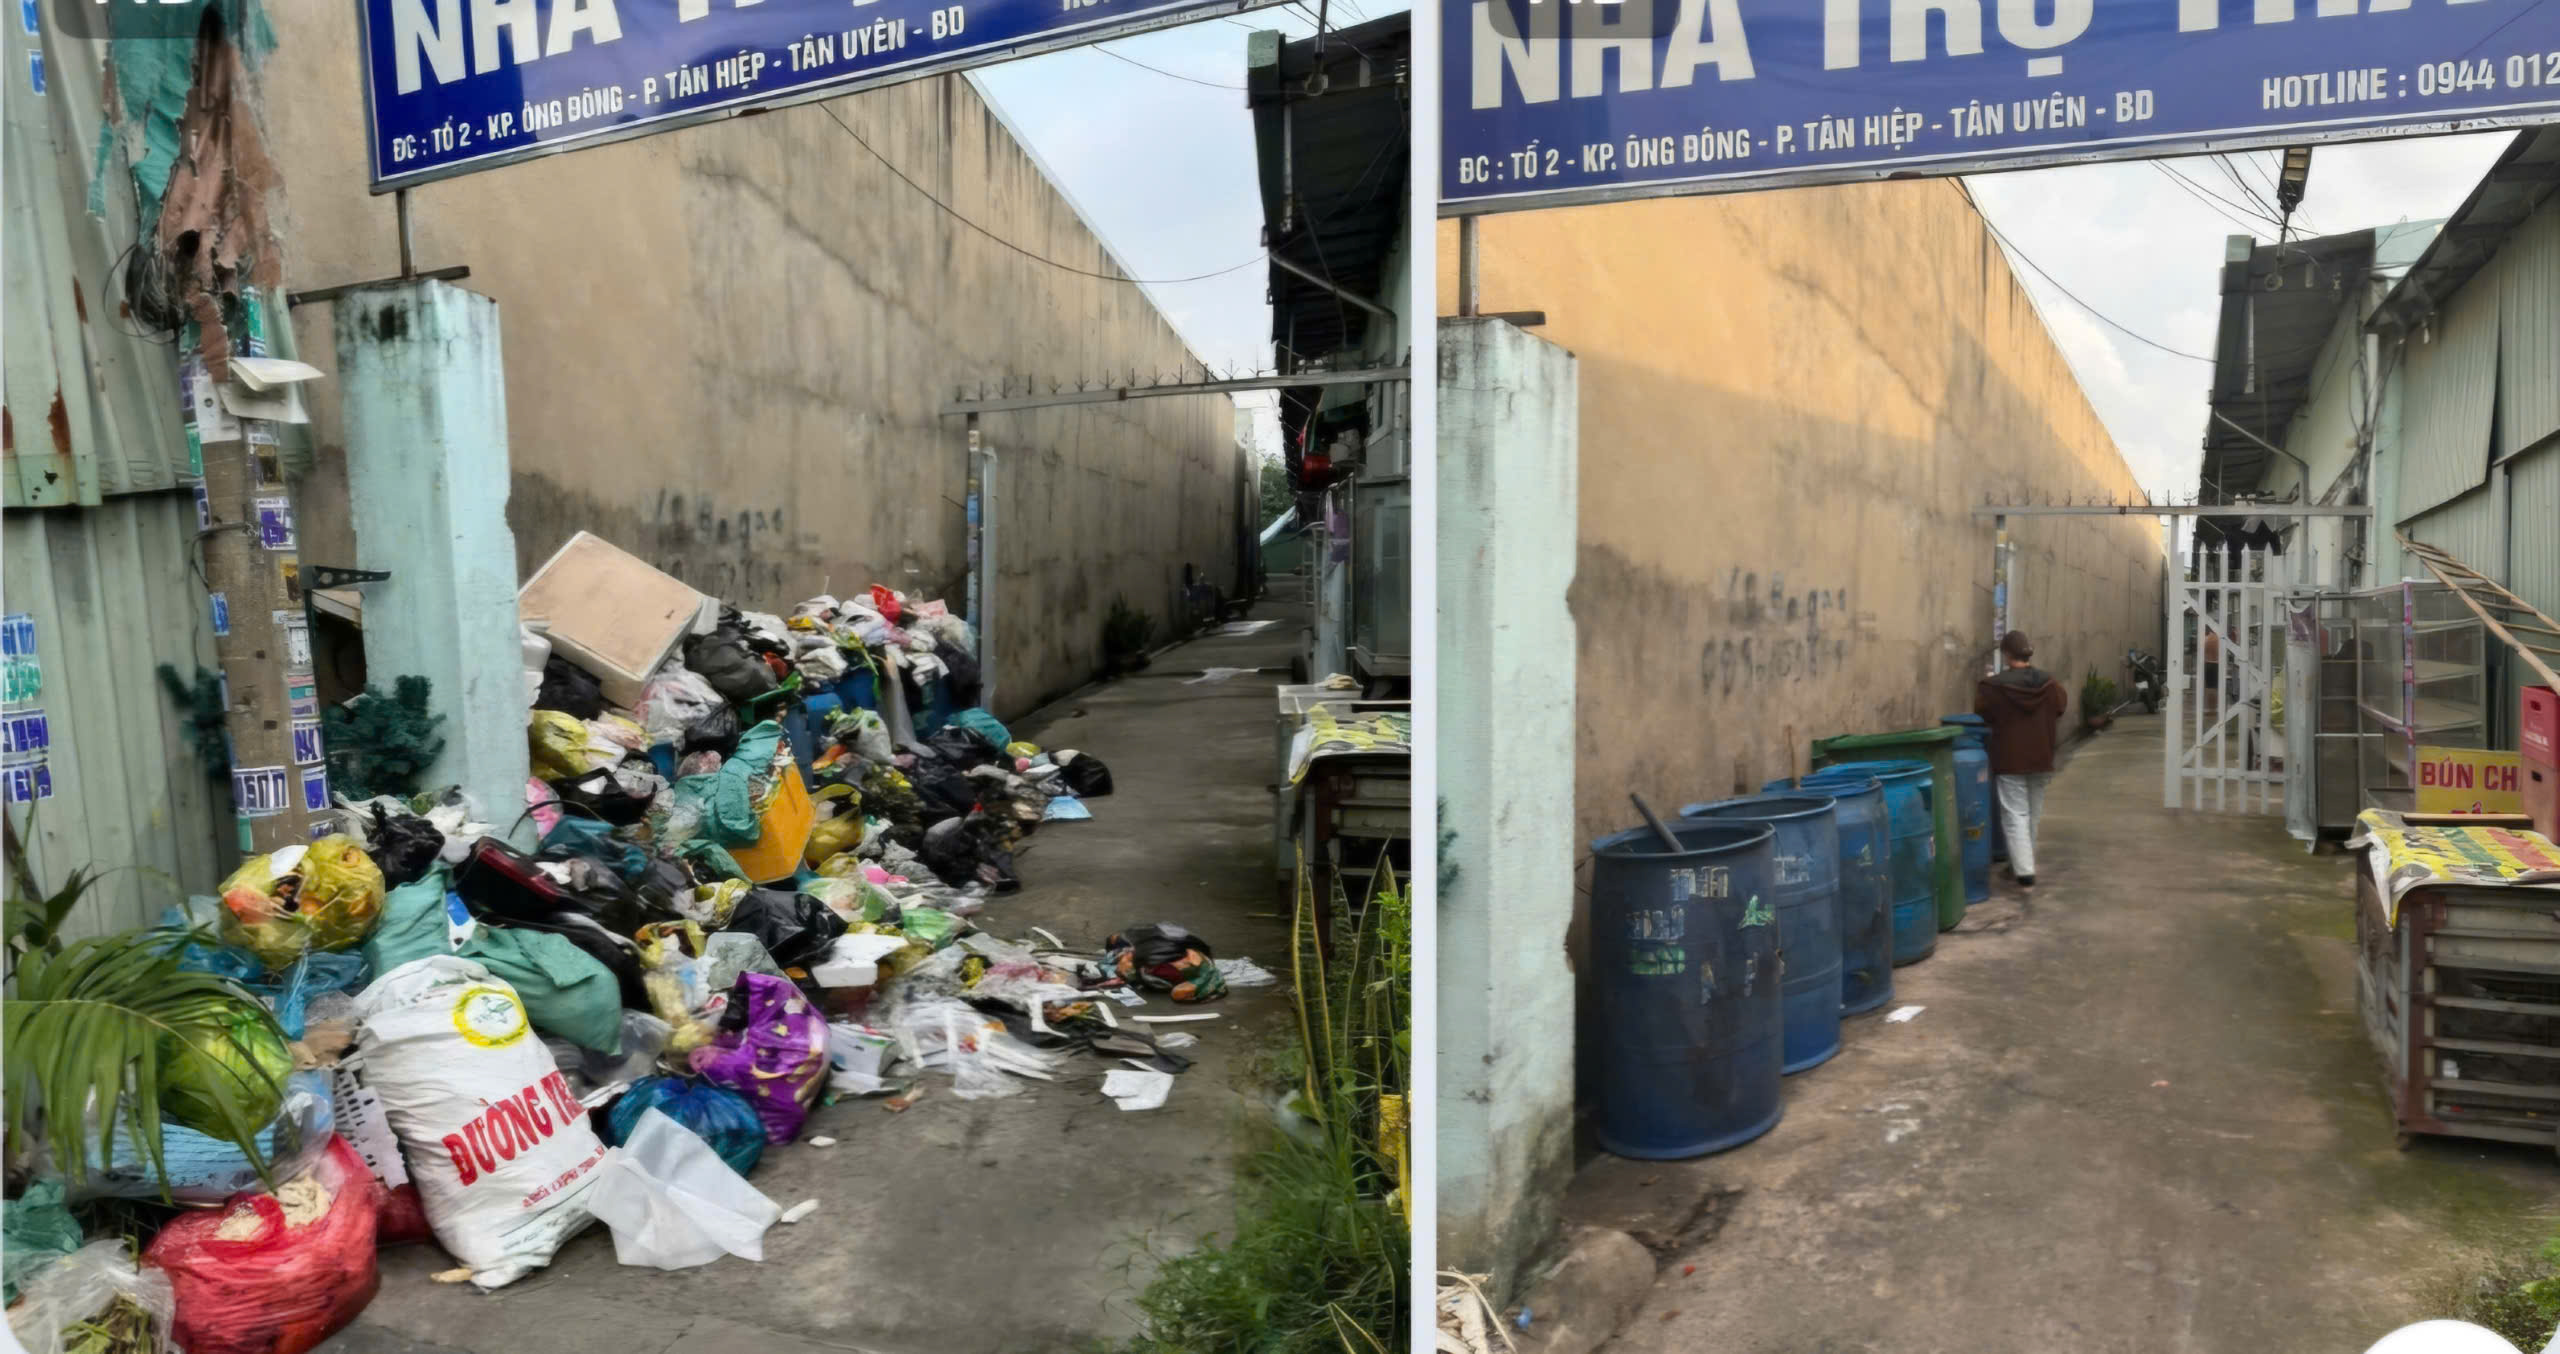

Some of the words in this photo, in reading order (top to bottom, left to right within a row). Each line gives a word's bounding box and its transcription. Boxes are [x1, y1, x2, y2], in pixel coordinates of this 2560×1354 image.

[459, 123, 471, 147] 2
[644, 78, 659, 105] P.
[665, 65, 709, 99] TÂN
[716, 50, 765, 89] HIỆP
[787, 34, 833, 71] TÂN
[843, 17, 905, 58] UYÊN
[932, 6, 965, 40] BD
[2263, 68, 2387, 110] HOTLINE
[2418, 58, 2495, 96] 0944
[2506, 51, 2560, 88] 012
[1460, 156, 1489, 184] ĐC
[1511, 139, 1540, 179] TỔ
[1545, 149, 1559, 176] 2
[1583, 143, 1616, 173] KP.
[1626, 134, 1674, 168] ÔNG
[1777, 125, 1795, 153] P.
[1804, 115, 1855, 151] TÂN
[1864, 107, 1923, 150] HIỆP
[1950, 100, 2004, 137] TÂN
[2013, 91, 2085, 131] UYÊN
[2116, 90, 2153, 122] BD
[2420, 756, 2474, 788] BÚN
[2484, 765, 2522, 792] CH
